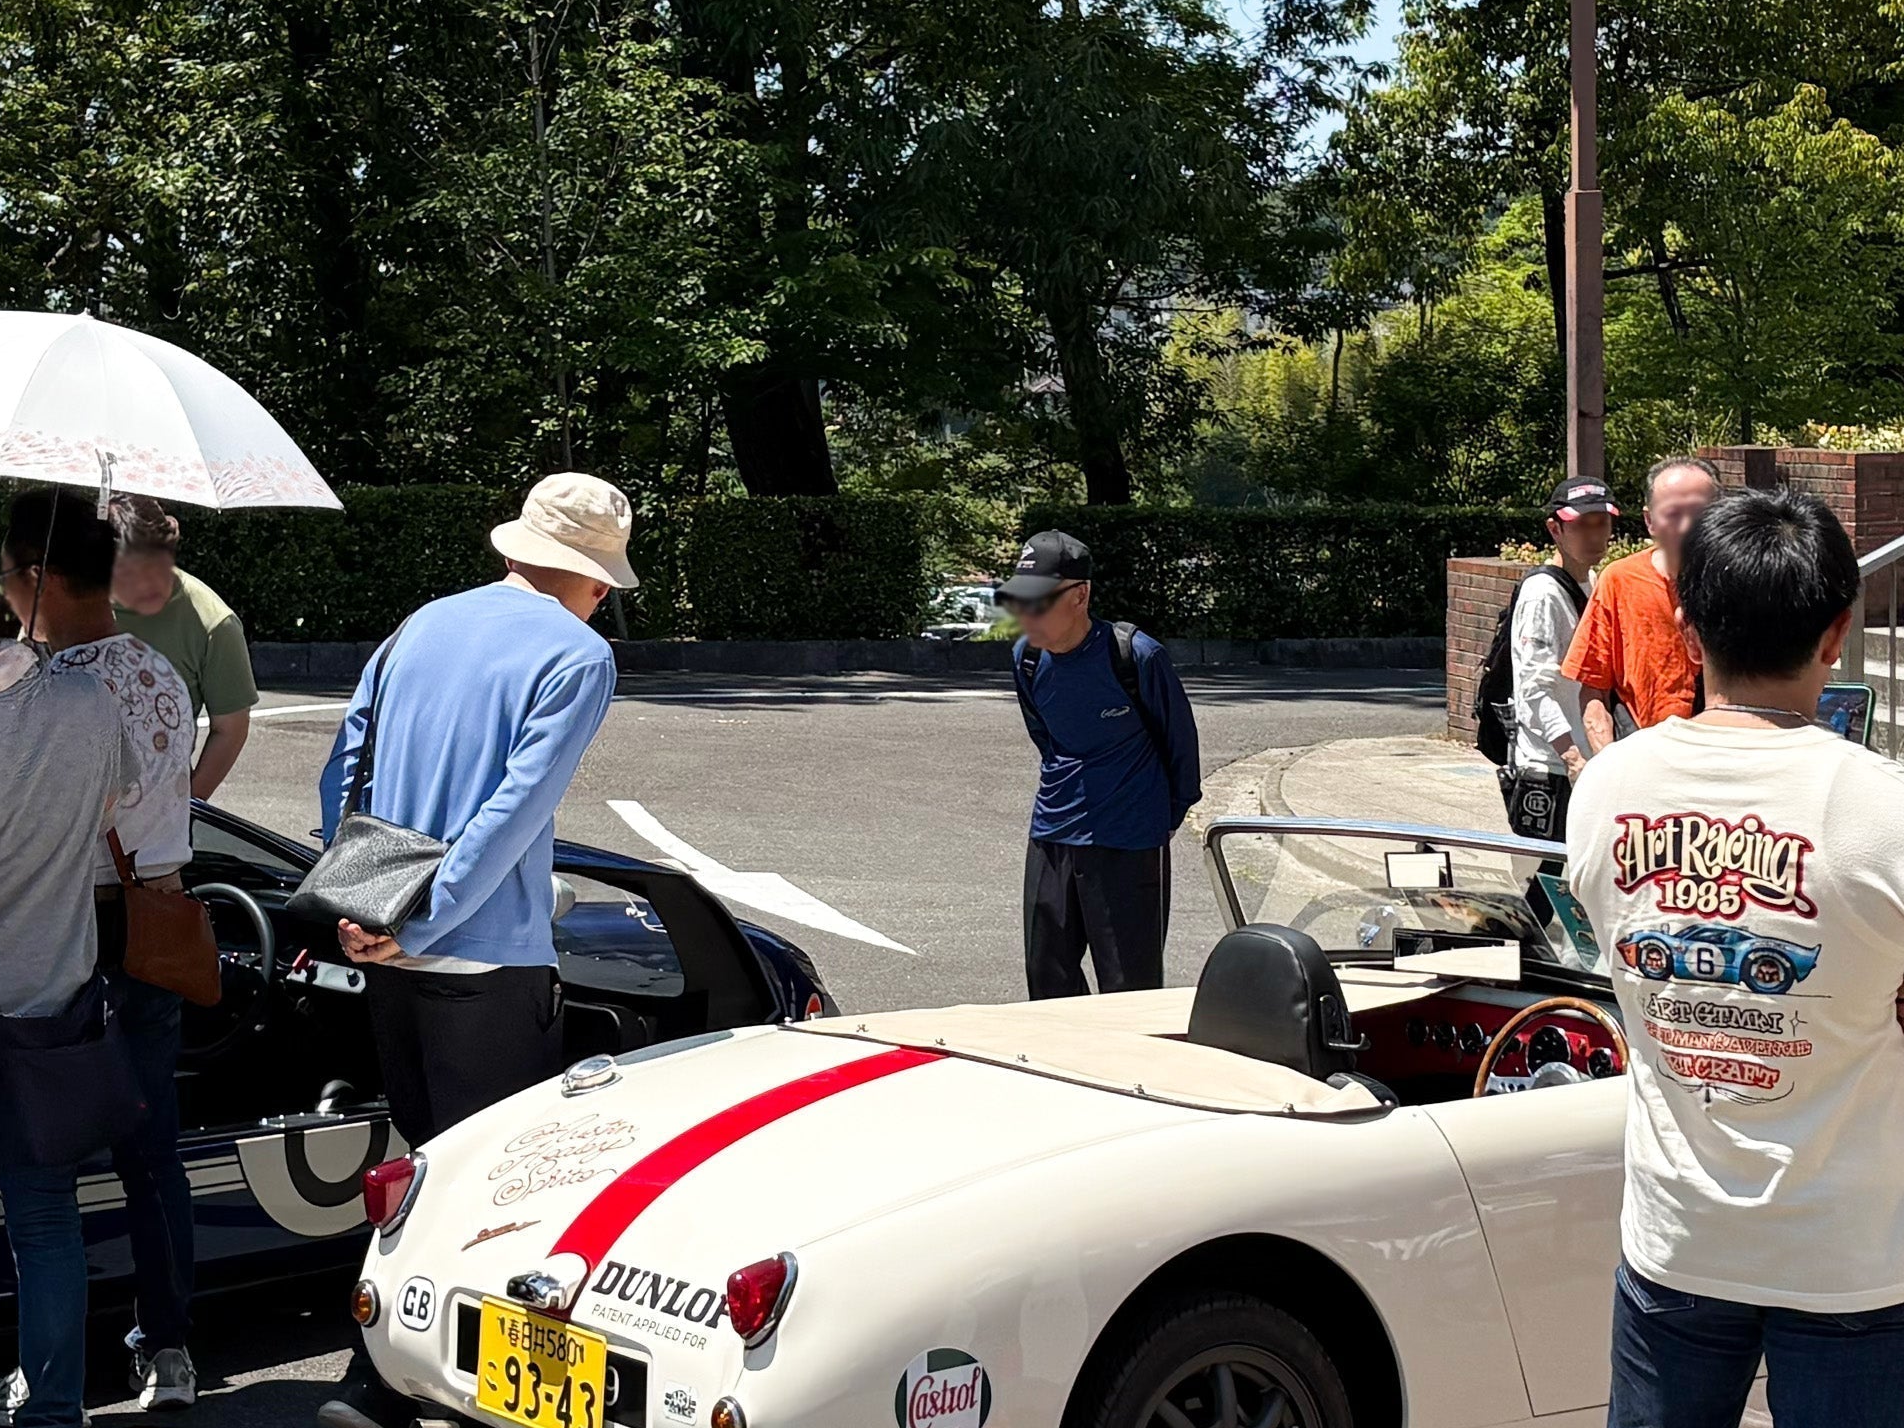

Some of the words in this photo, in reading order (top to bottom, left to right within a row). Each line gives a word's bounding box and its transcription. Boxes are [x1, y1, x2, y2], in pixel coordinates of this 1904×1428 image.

[1659, 877, 1742, 915] 1985
[1696, 947, 1715, 975] 6
[1646, 992, 1693, 1024] ART
[1663, 1052, 1694, 1078] RT
[1696, 1055, 1781, 1089] CRAFT
[591, 1303, 635, 1328] PATENT
[632, 1316, 682, 1342] APPLIED
[682, 1331, 708, 1350] FOR
